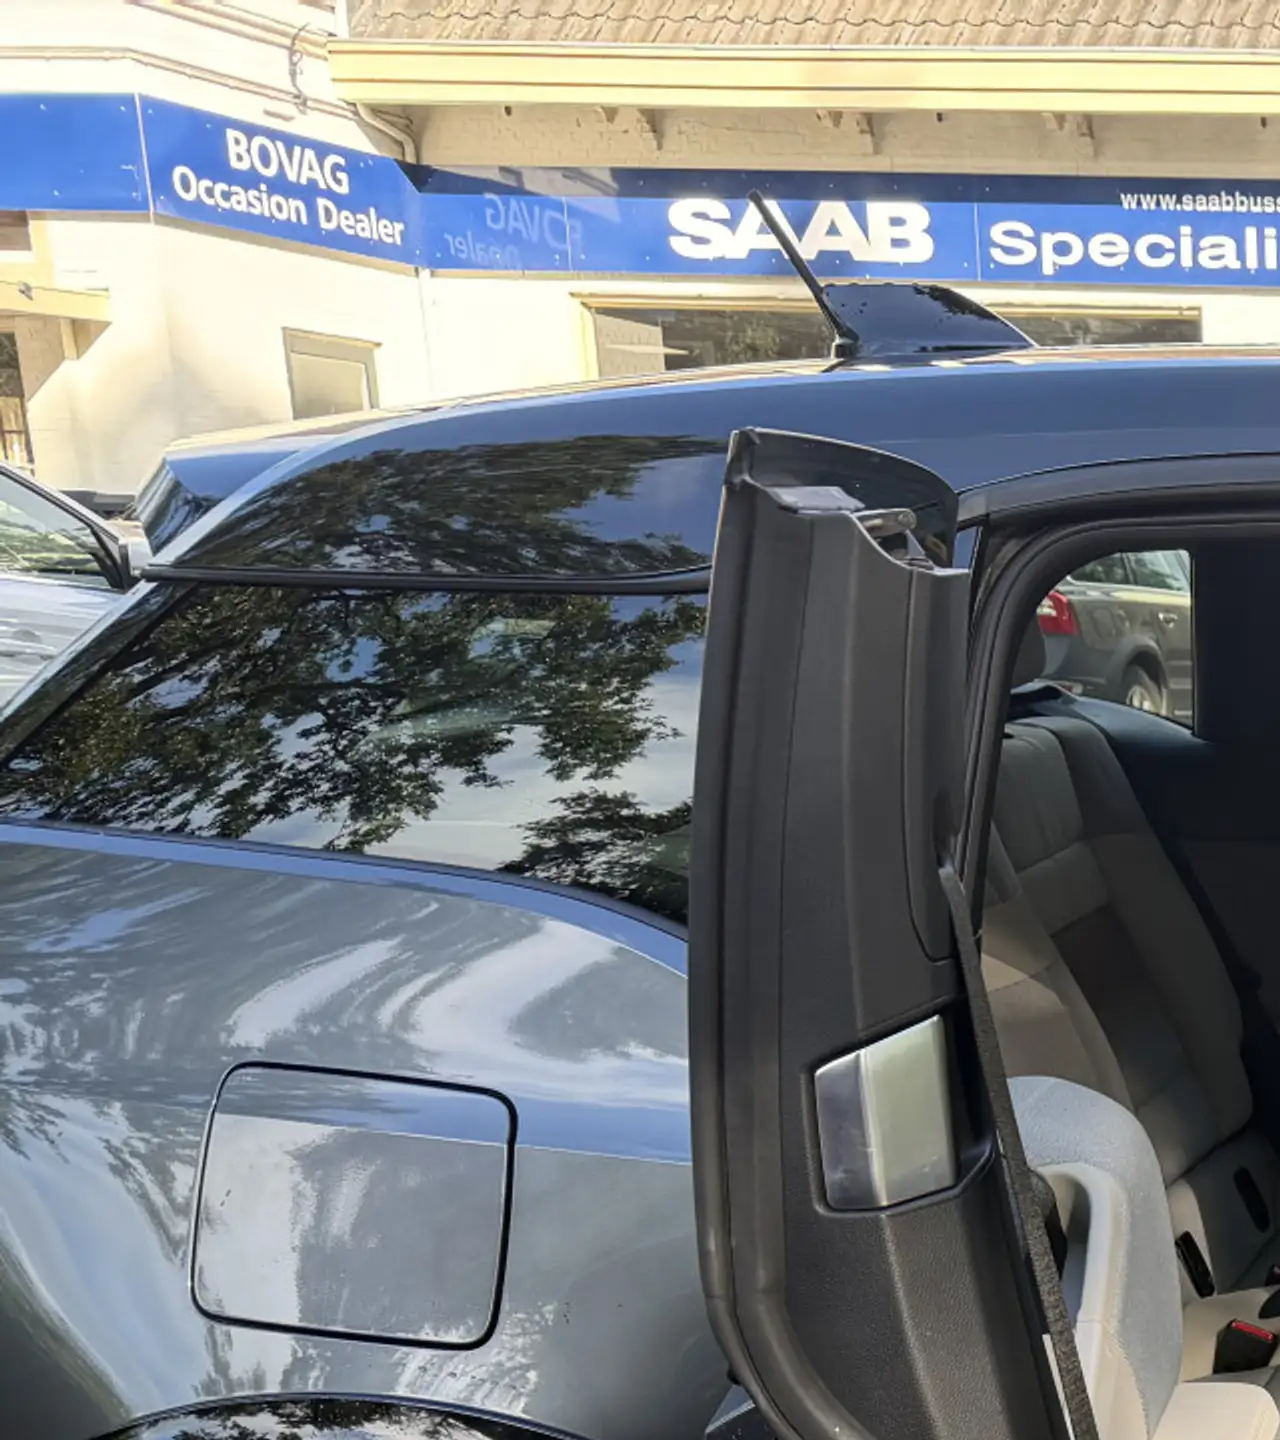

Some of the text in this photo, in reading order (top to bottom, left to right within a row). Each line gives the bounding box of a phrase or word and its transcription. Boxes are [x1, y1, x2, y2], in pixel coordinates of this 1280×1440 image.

[225, 127, 350, 195] BOVAG
[171, 165, 405, 246] Occasion Dealer
[667, 197, 934, 264] SAAB
